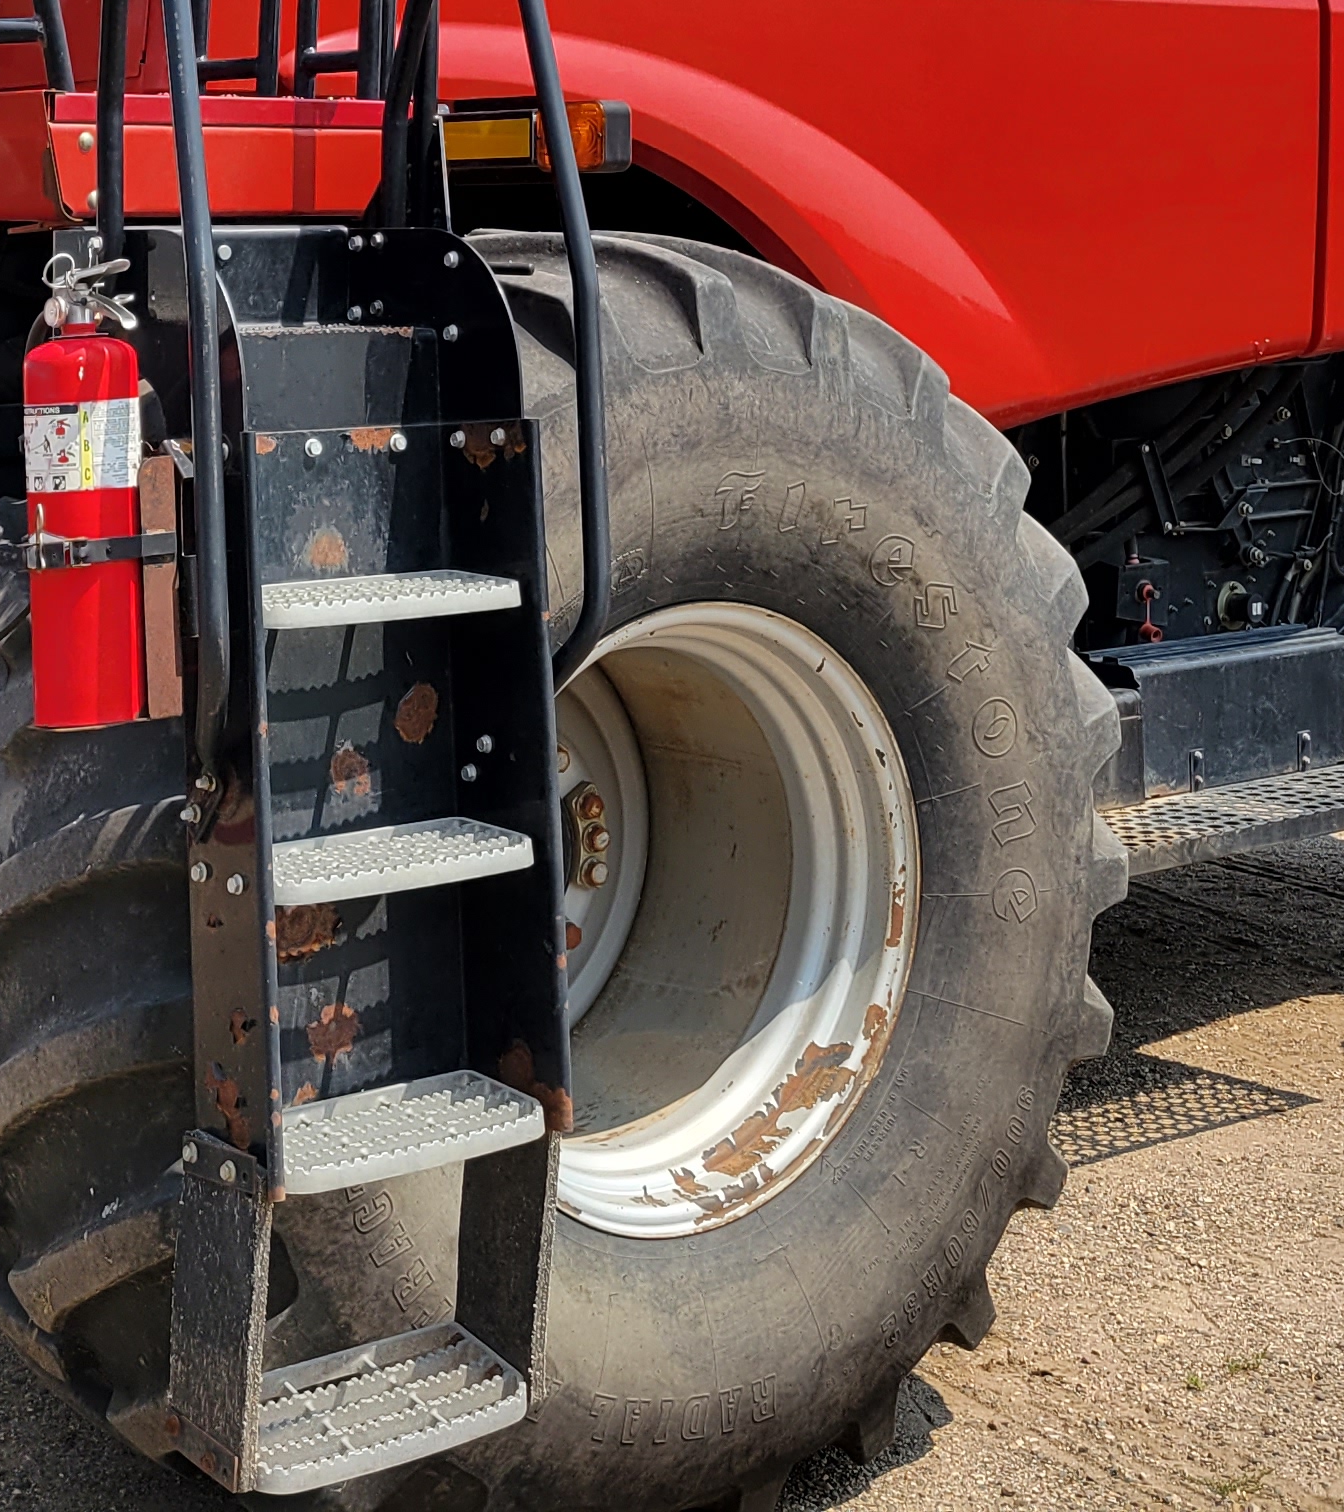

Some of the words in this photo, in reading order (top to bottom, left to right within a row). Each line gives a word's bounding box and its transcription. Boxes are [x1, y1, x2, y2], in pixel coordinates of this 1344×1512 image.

[83, 411, 89, 424] A
[83, 439, 90, 452] B
[84, 467, 91, 481] C
[714, 468, 1038, 924] Firestone
[588, 1373, 778, 1446] RADIAL
